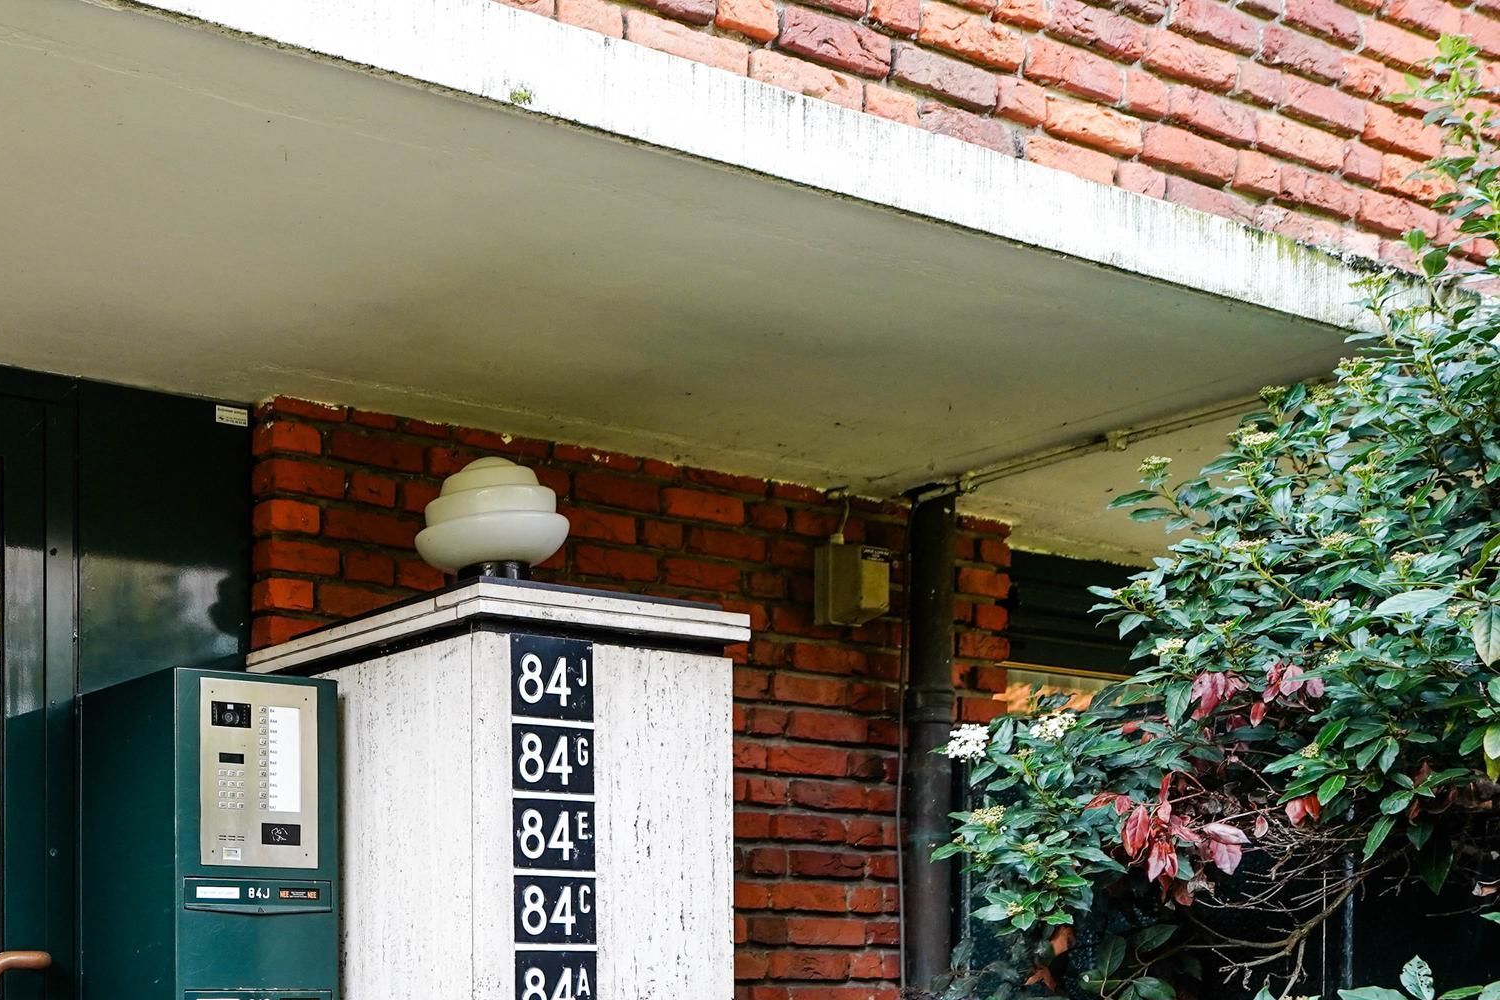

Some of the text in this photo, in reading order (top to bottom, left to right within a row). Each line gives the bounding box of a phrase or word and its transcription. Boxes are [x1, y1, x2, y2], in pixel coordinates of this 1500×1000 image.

[518, 653, 587, 707] 84J
[519, 732, 589, 786] 84G
[520, 808, 590, 861] 84E
[248, 887, 270, 899] 84J
[280, 890, 289, 898] NEE
[307, 891, 317, 899] NEE
[521, 884, 591, 935] 84C
